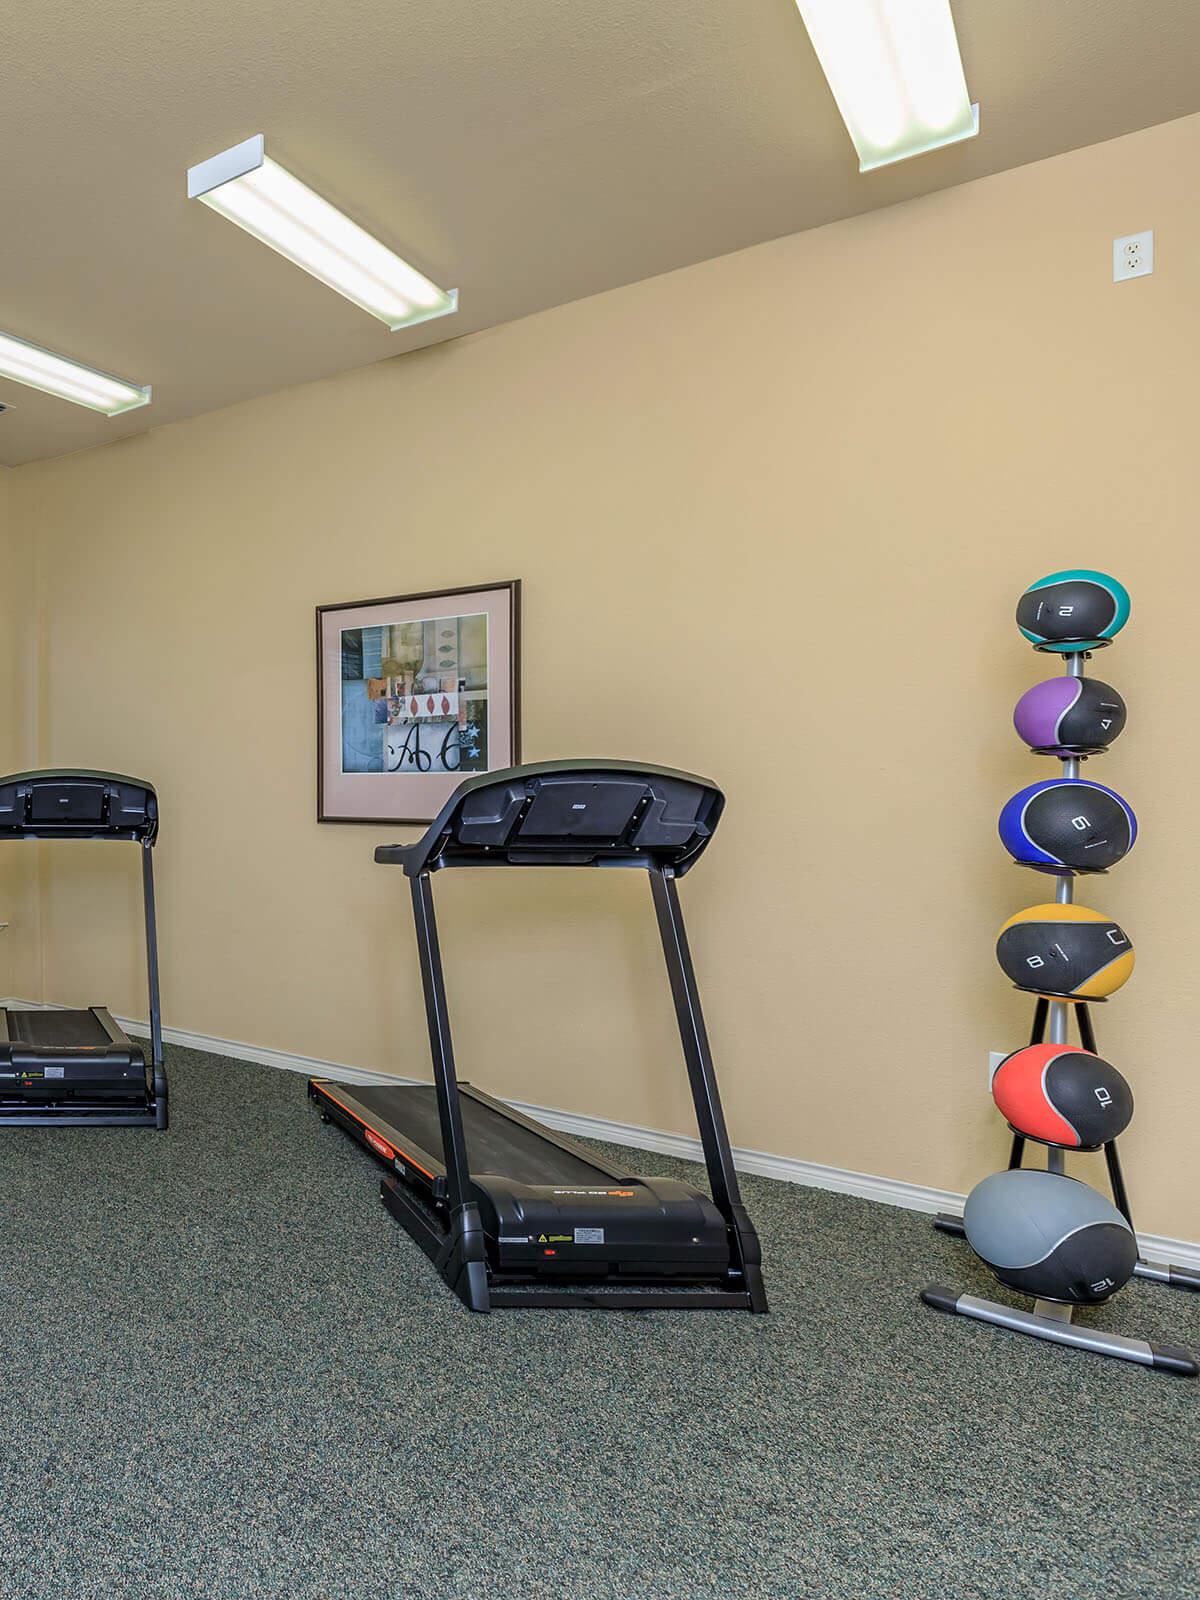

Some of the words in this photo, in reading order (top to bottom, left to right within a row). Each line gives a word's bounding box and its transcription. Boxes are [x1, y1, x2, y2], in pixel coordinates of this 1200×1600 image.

[1058, 606, 1074, 616] 2
[1100, 719, 1113, 730] 4
[1071, 815, 1091, 830] 6
[1026, 955, 1044, 968] 8
[1094, 1087, 1113, 1109] 10
[1090, 1277, 1116, 1292] 12
